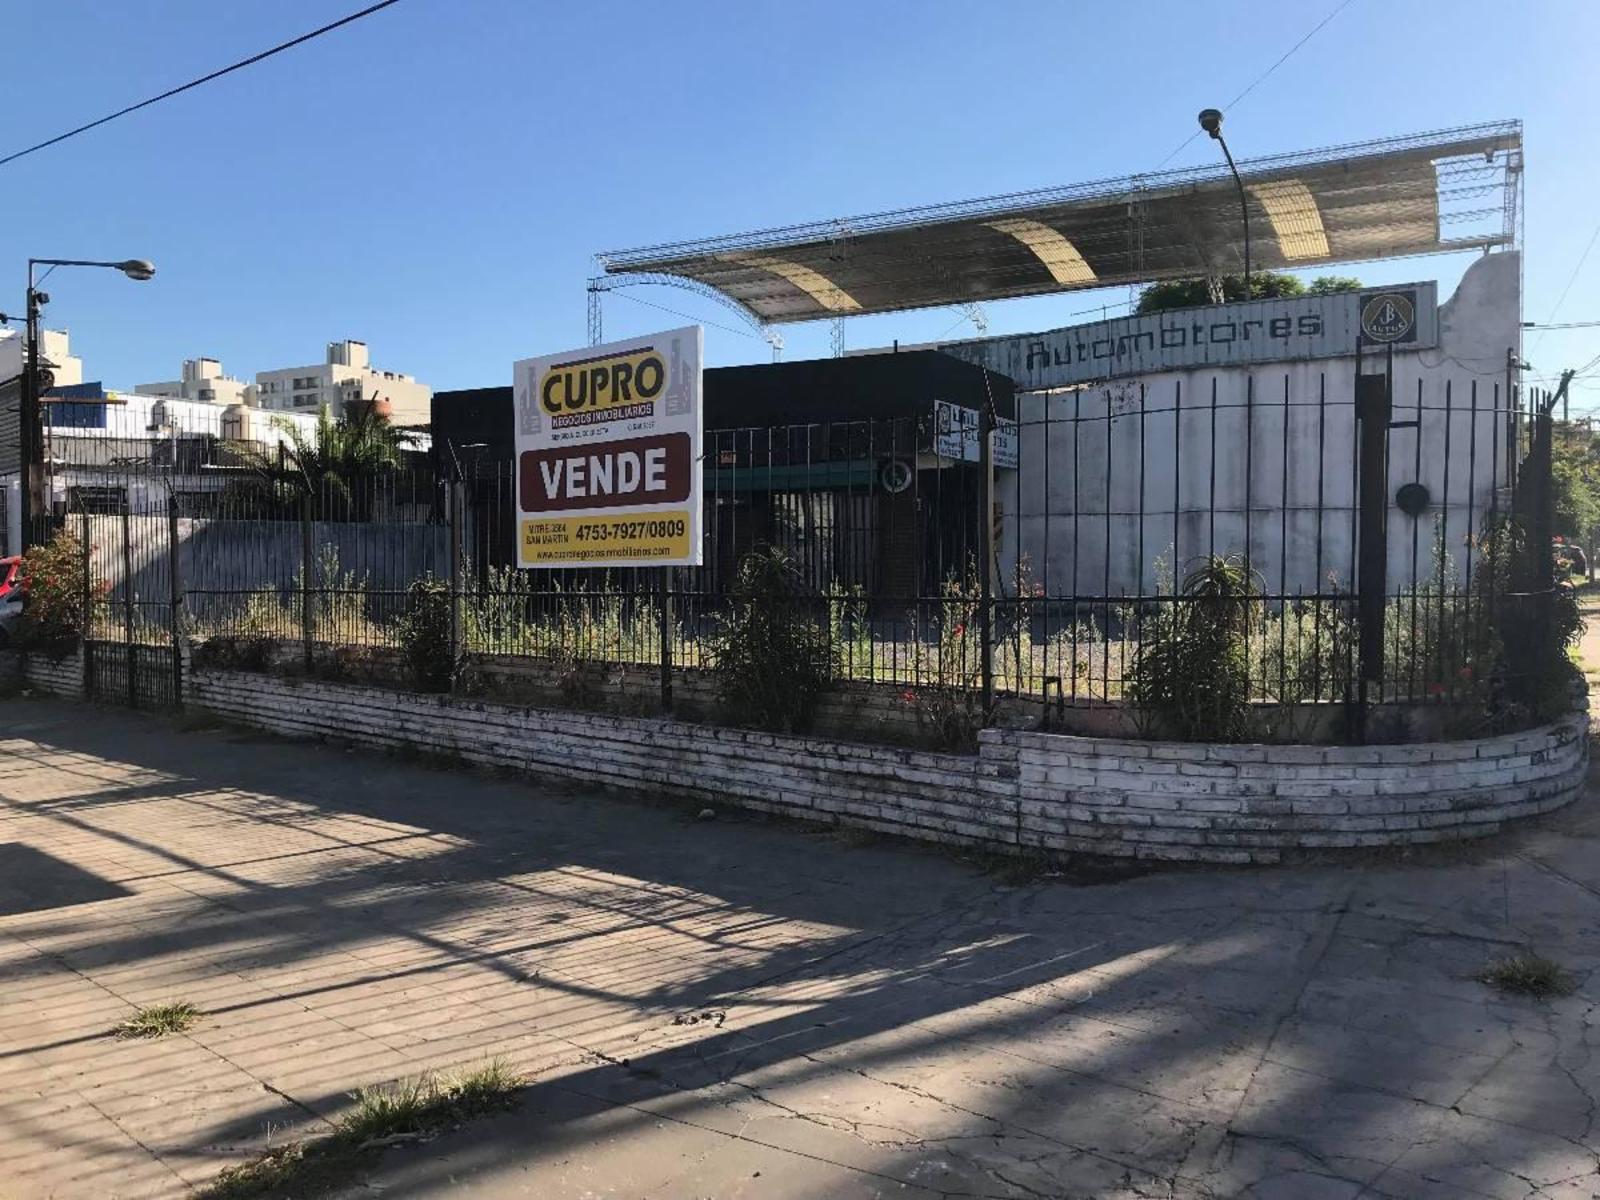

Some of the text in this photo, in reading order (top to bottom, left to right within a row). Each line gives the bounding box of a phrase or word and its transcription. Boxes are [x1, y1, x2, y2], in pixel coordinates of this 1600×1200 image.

[1026, 313, 1322, 369] Automotores
[542, 356, 665, 412] CUPRO
[552, 404, 652, 428] NEGOCIOS INMOBILIARIOS
[540, 447, 667, 500] VENDE
[575, 520, 685, 541] 4753-7927/0809
